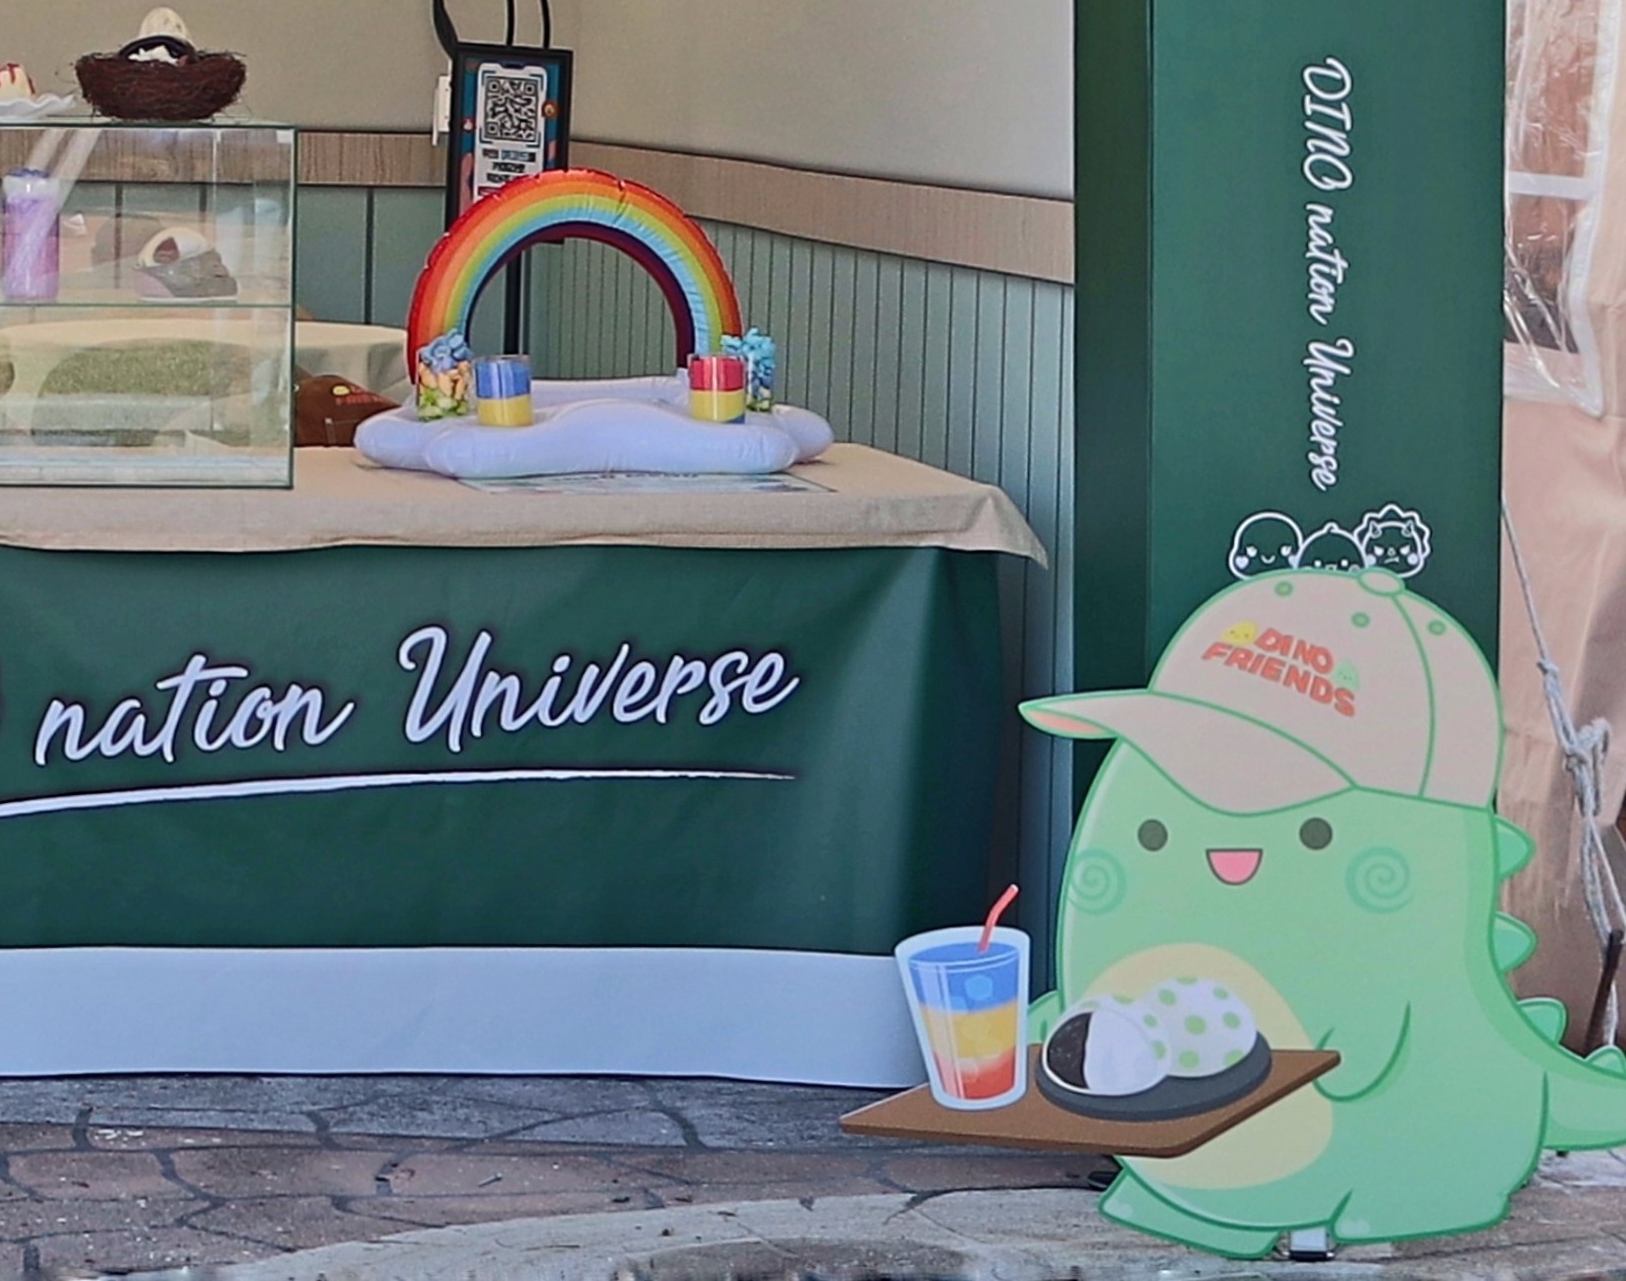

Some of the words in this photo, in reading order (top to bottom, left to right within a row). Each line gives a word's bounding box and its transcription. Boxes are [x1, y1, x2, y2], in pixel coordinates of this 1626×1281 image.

[1302, 56, 1354, 191] DINO
[1304, 203, 1349, 326] nation
[1303, 338, 1355, 491] Universe
[34, 655, 355, 766] nation
[398, 624, 800, 753] Universe
[1201, 641, 1357, 718] FRIENDS
[1254, 627, 1335, 675] DINO
